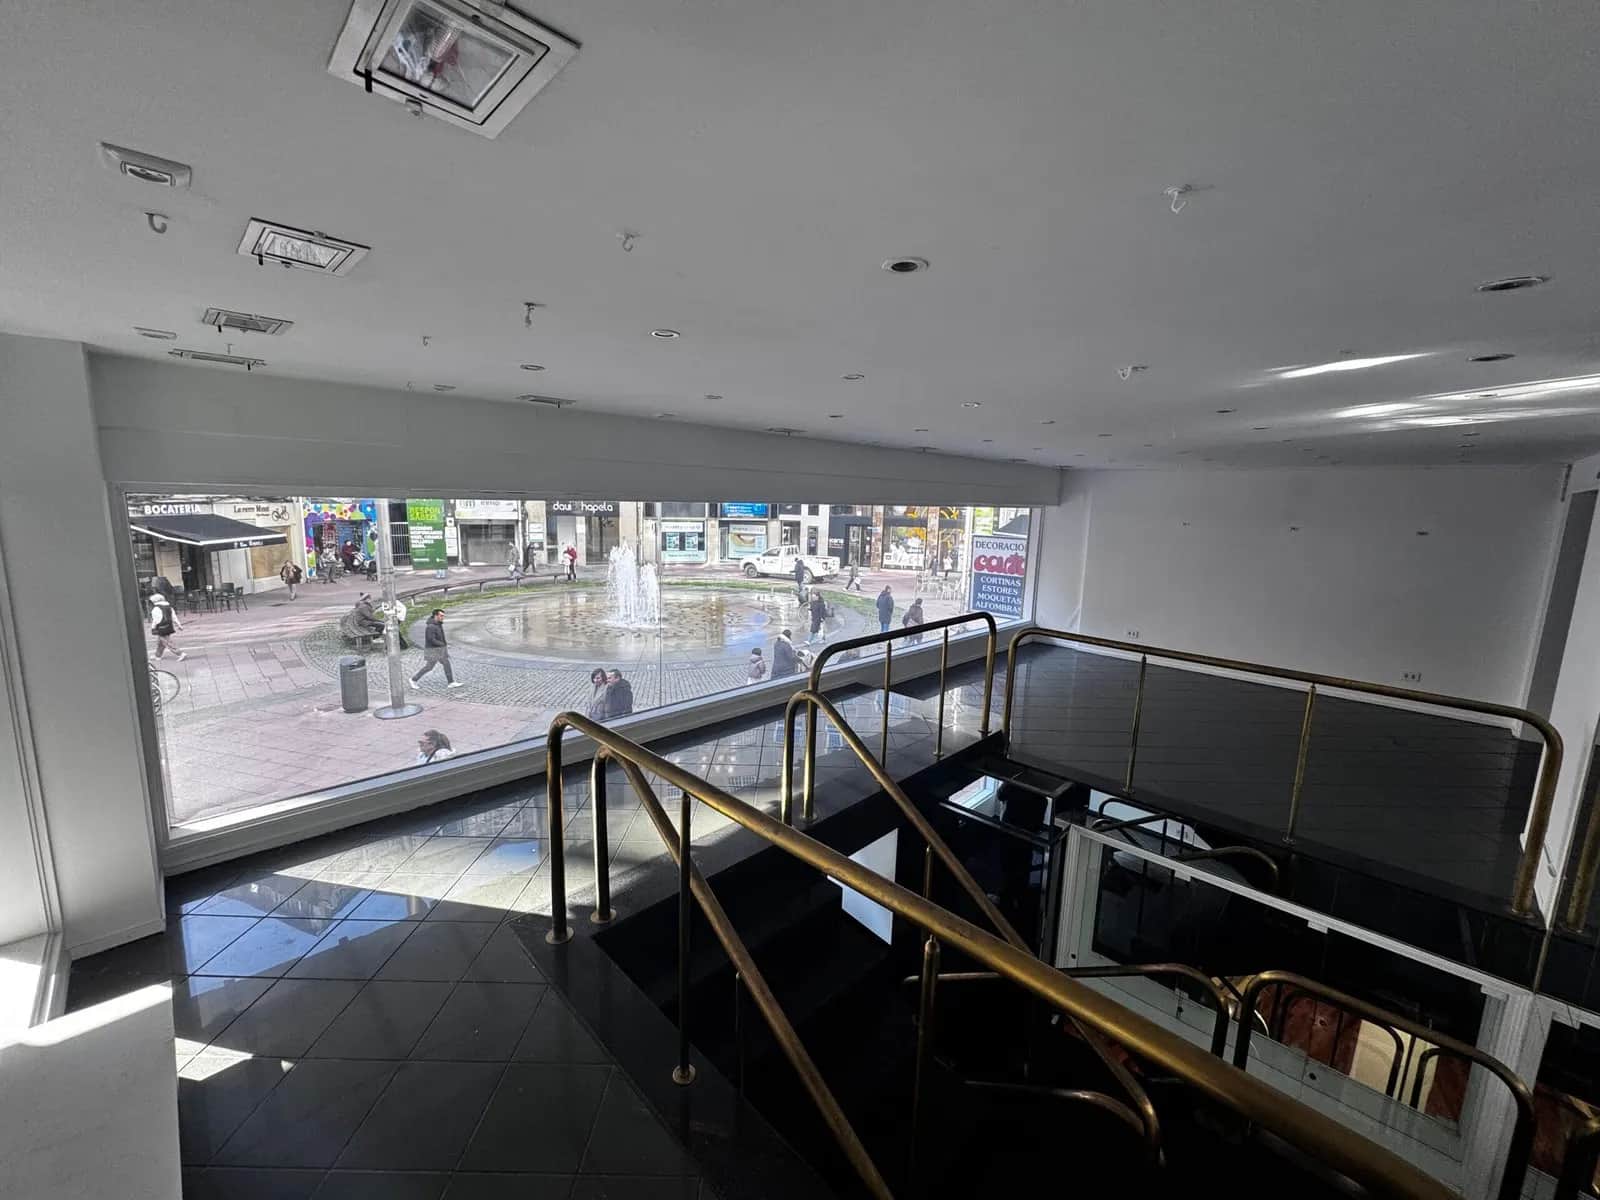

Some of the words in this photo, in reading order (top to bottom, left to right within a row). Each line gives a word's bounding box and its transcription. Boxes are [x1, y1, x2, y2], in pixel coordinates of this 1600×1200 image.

[144, 503, 201, 514] BOCATERIA
[980, 575, 1021, 587] CORTINAS
[982, 584, 1018, 596] ESTORES
[976, 592, 1022, 605] MOQUETAS
